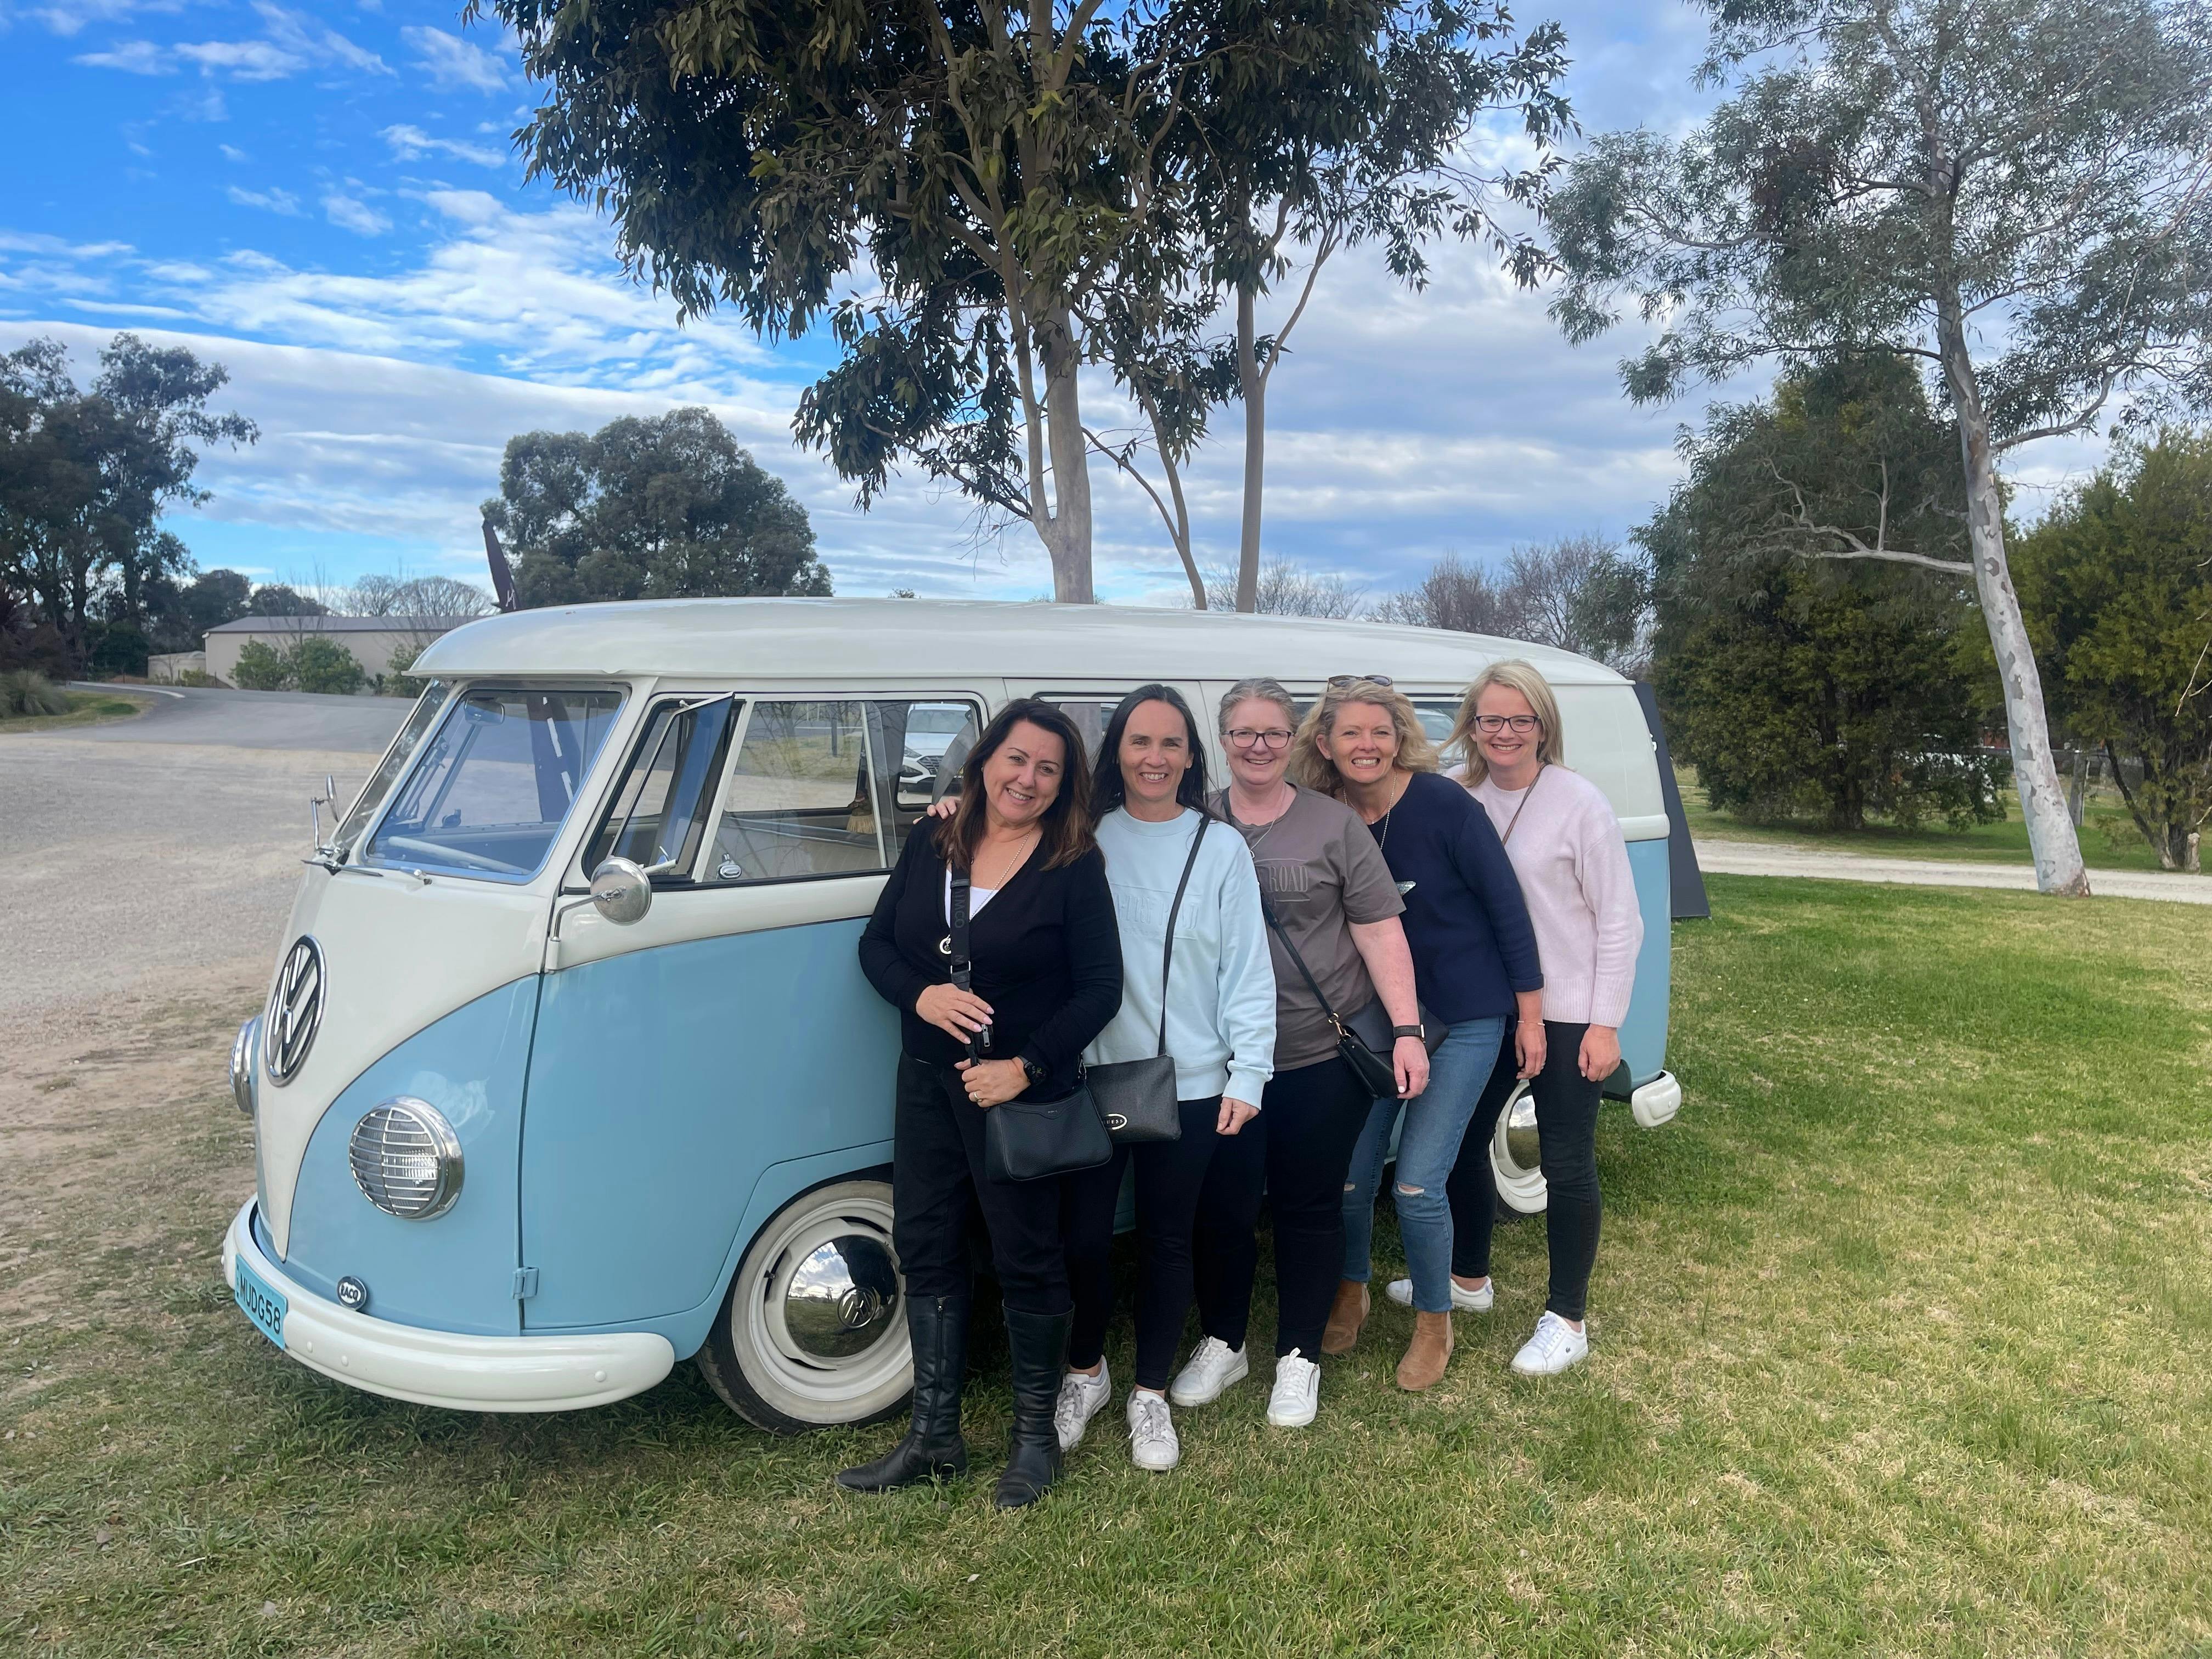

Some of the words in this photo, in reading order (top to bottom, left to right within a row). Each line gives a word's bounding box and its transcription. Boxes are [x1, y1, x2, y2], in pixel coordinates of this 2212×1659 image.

[1267, 864, 1308, 892] ROAD
[267, 936, 324, 1082] VW
[240, 1273, 281, 1334] MUDG58
